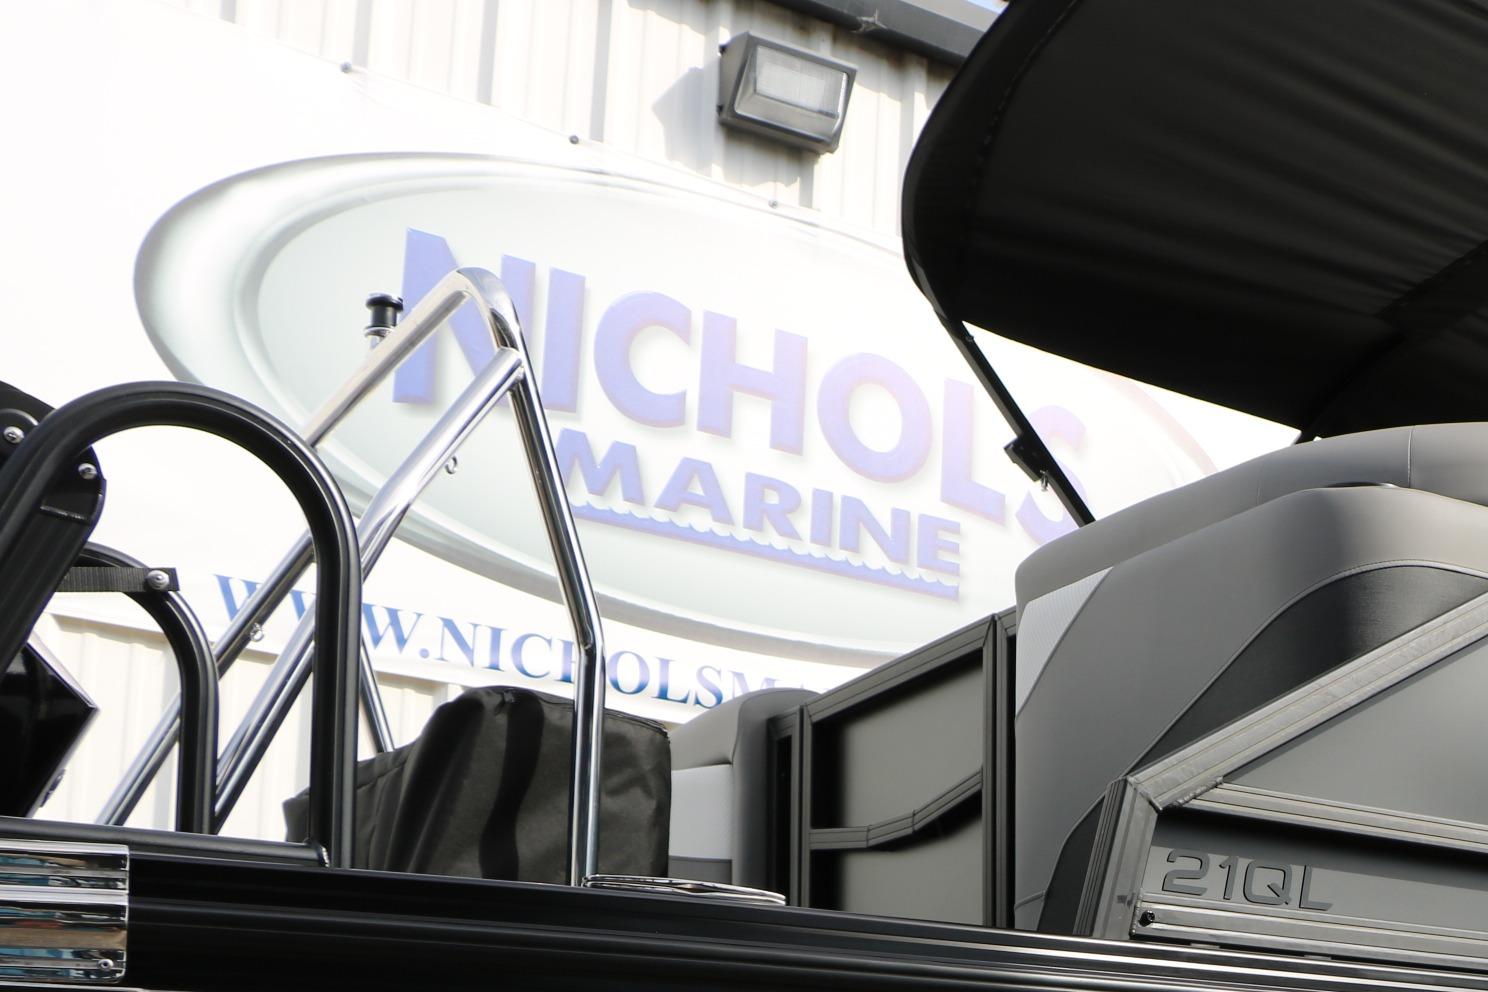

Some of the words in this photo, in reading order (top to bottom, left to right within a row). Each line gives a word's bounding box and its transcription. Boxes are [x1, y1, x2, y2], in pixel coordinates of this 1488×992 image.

[393, 227, 1087, 545] NICHOLS
[555, 427, 961, 575] MARINE
[1162, 849, 1333, 912] 21QL
